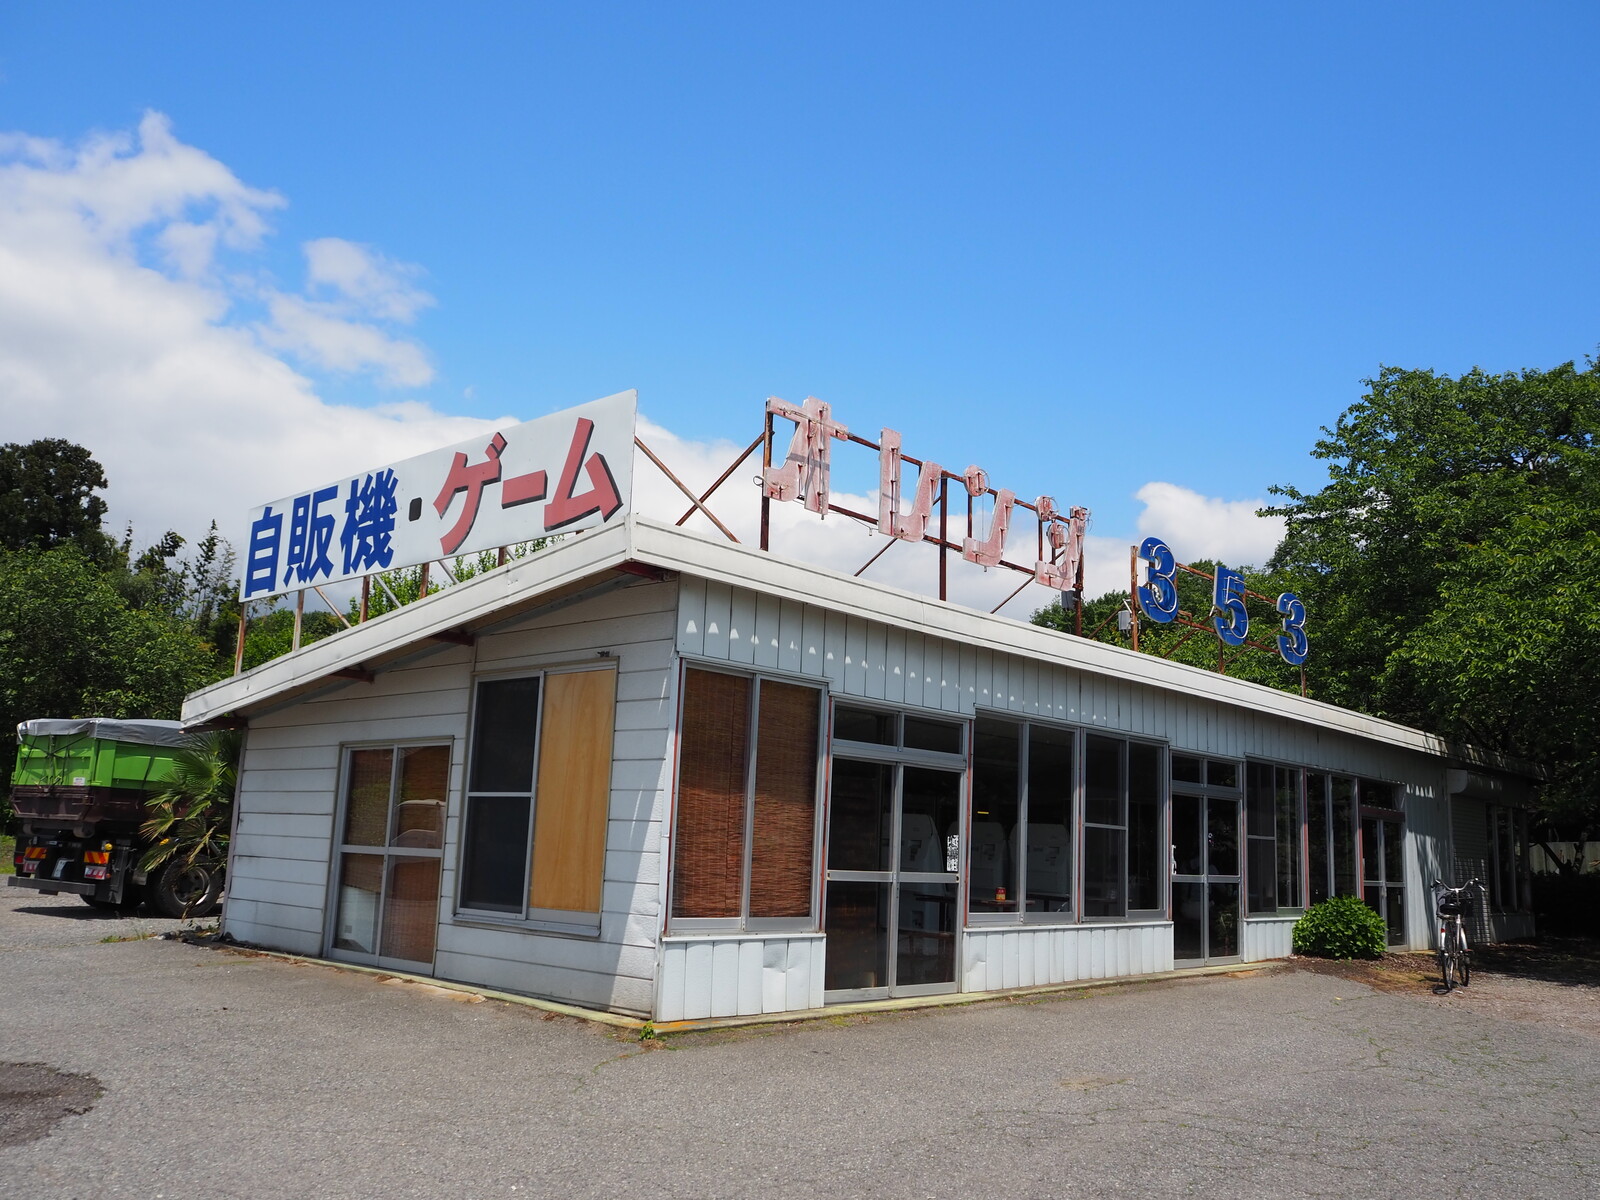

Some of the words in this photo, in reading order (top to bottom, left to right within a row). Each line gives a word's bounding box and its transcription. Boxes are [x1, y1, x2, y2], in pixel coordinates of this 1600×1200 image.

[245, 417, 623, 598] 自販機・ゲーム
[1137, 537, 1308, 665] 353
